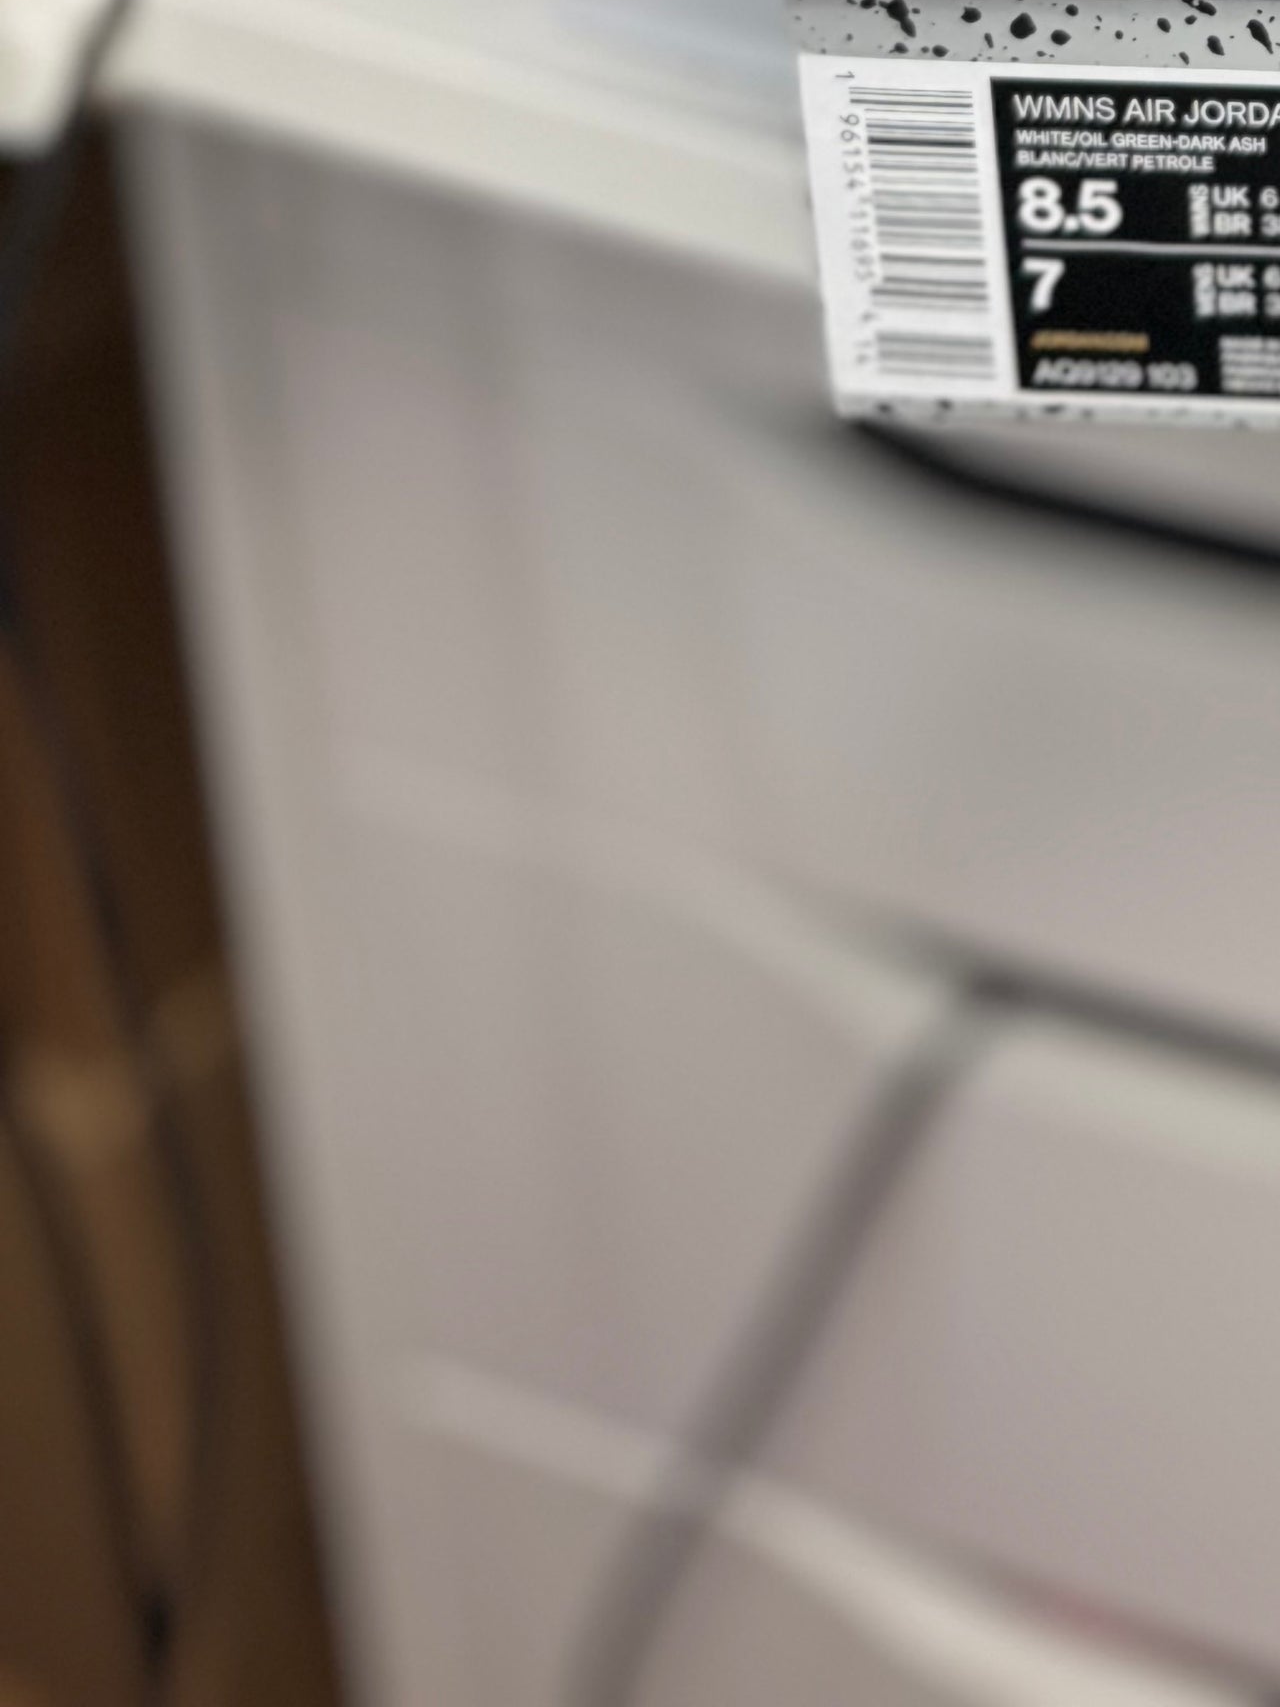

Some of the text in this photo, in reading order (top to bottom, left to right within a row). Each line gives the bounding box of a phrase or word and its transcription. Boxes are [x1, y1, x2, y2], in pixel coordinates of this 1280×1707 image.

[1014, 94, 1117, 124] WMNS
[1121, 97, 1177, 125] AIR
[1015, 129, 1267, 154] WHITE/OIL GREEN-DARK ASH
[1015, 150, 1216, 173] BLANC/VERT PETROLE
[1016, 177, 1124, 234] 8.5
[1212, 185, 1280, 210] UK 6
[1213, 212, 1252, 237] BR
[1021, 257, 1065, 313] 7
